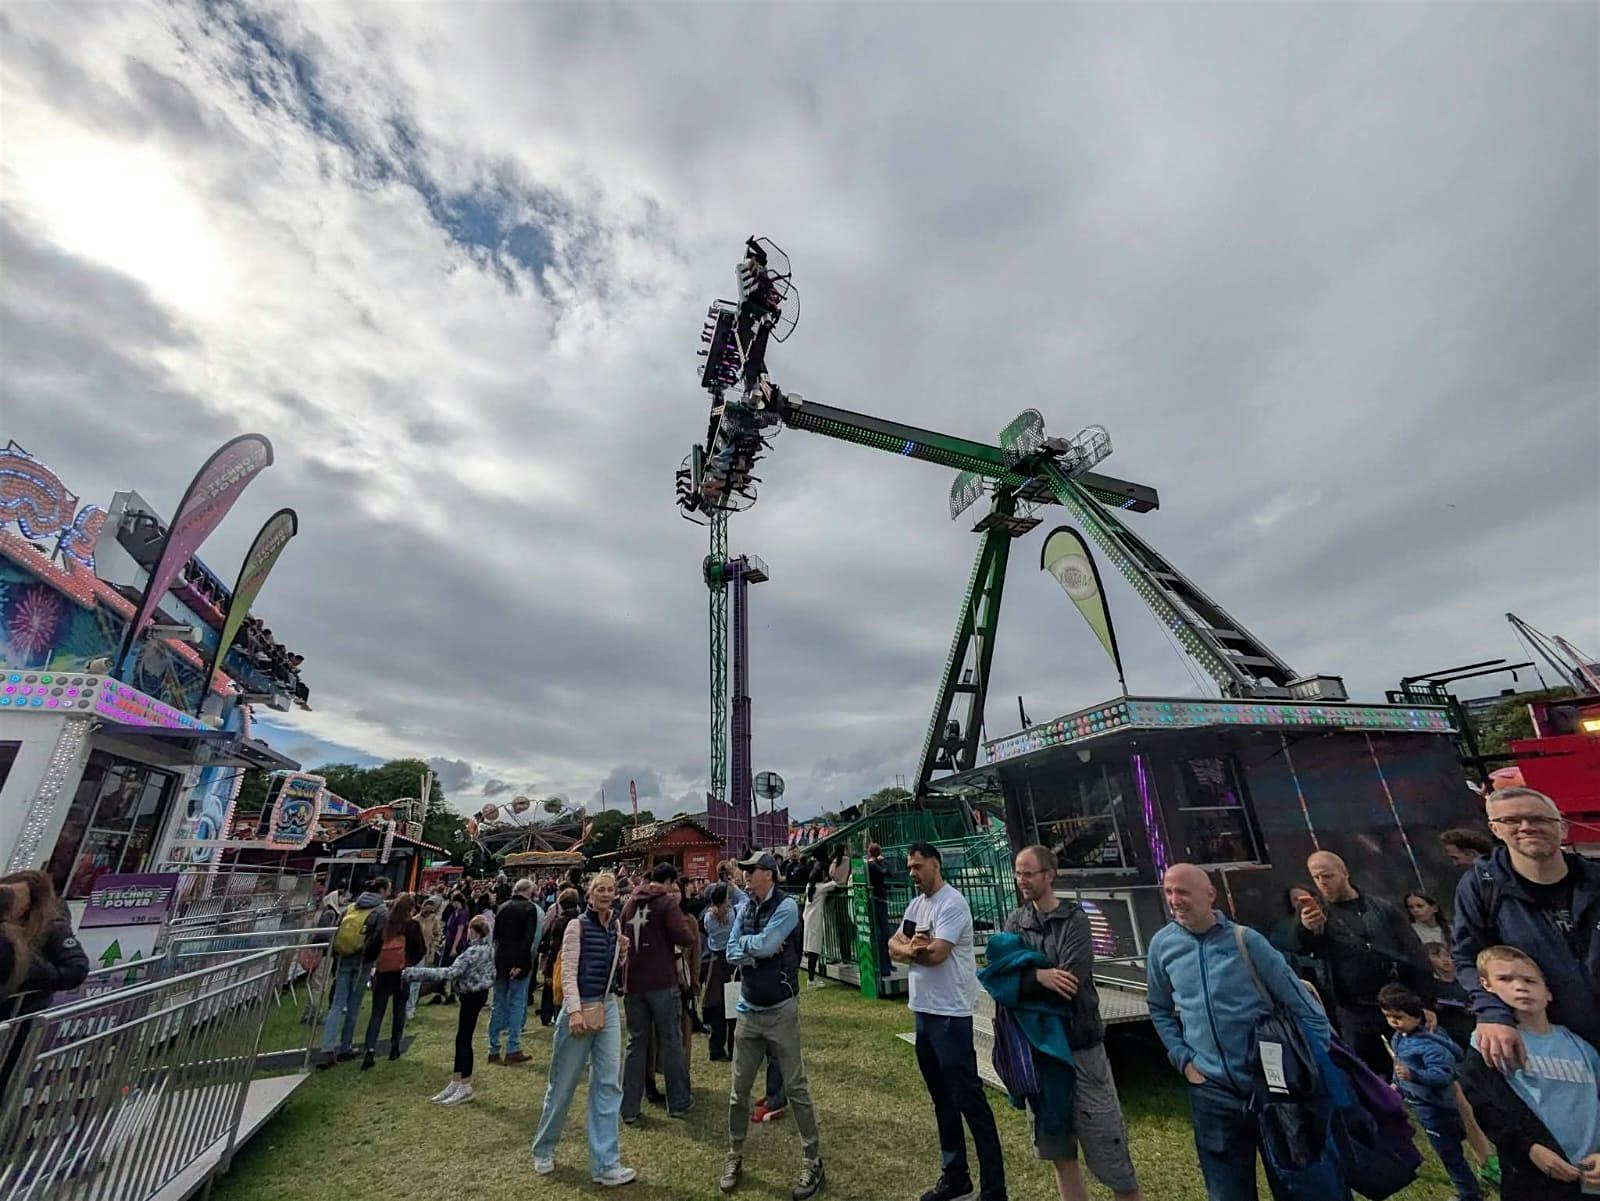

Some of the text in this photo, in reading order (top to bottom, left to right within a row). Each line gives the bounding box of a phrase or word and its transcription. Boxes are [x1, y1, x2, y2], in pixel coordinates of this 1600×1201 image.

[207, 457, 251, 491] TECHNO
[210, 464, 256, 498] POWER
[104, 898, 151, 909] POWER
[107, 890, 153, 900] TECHNO
